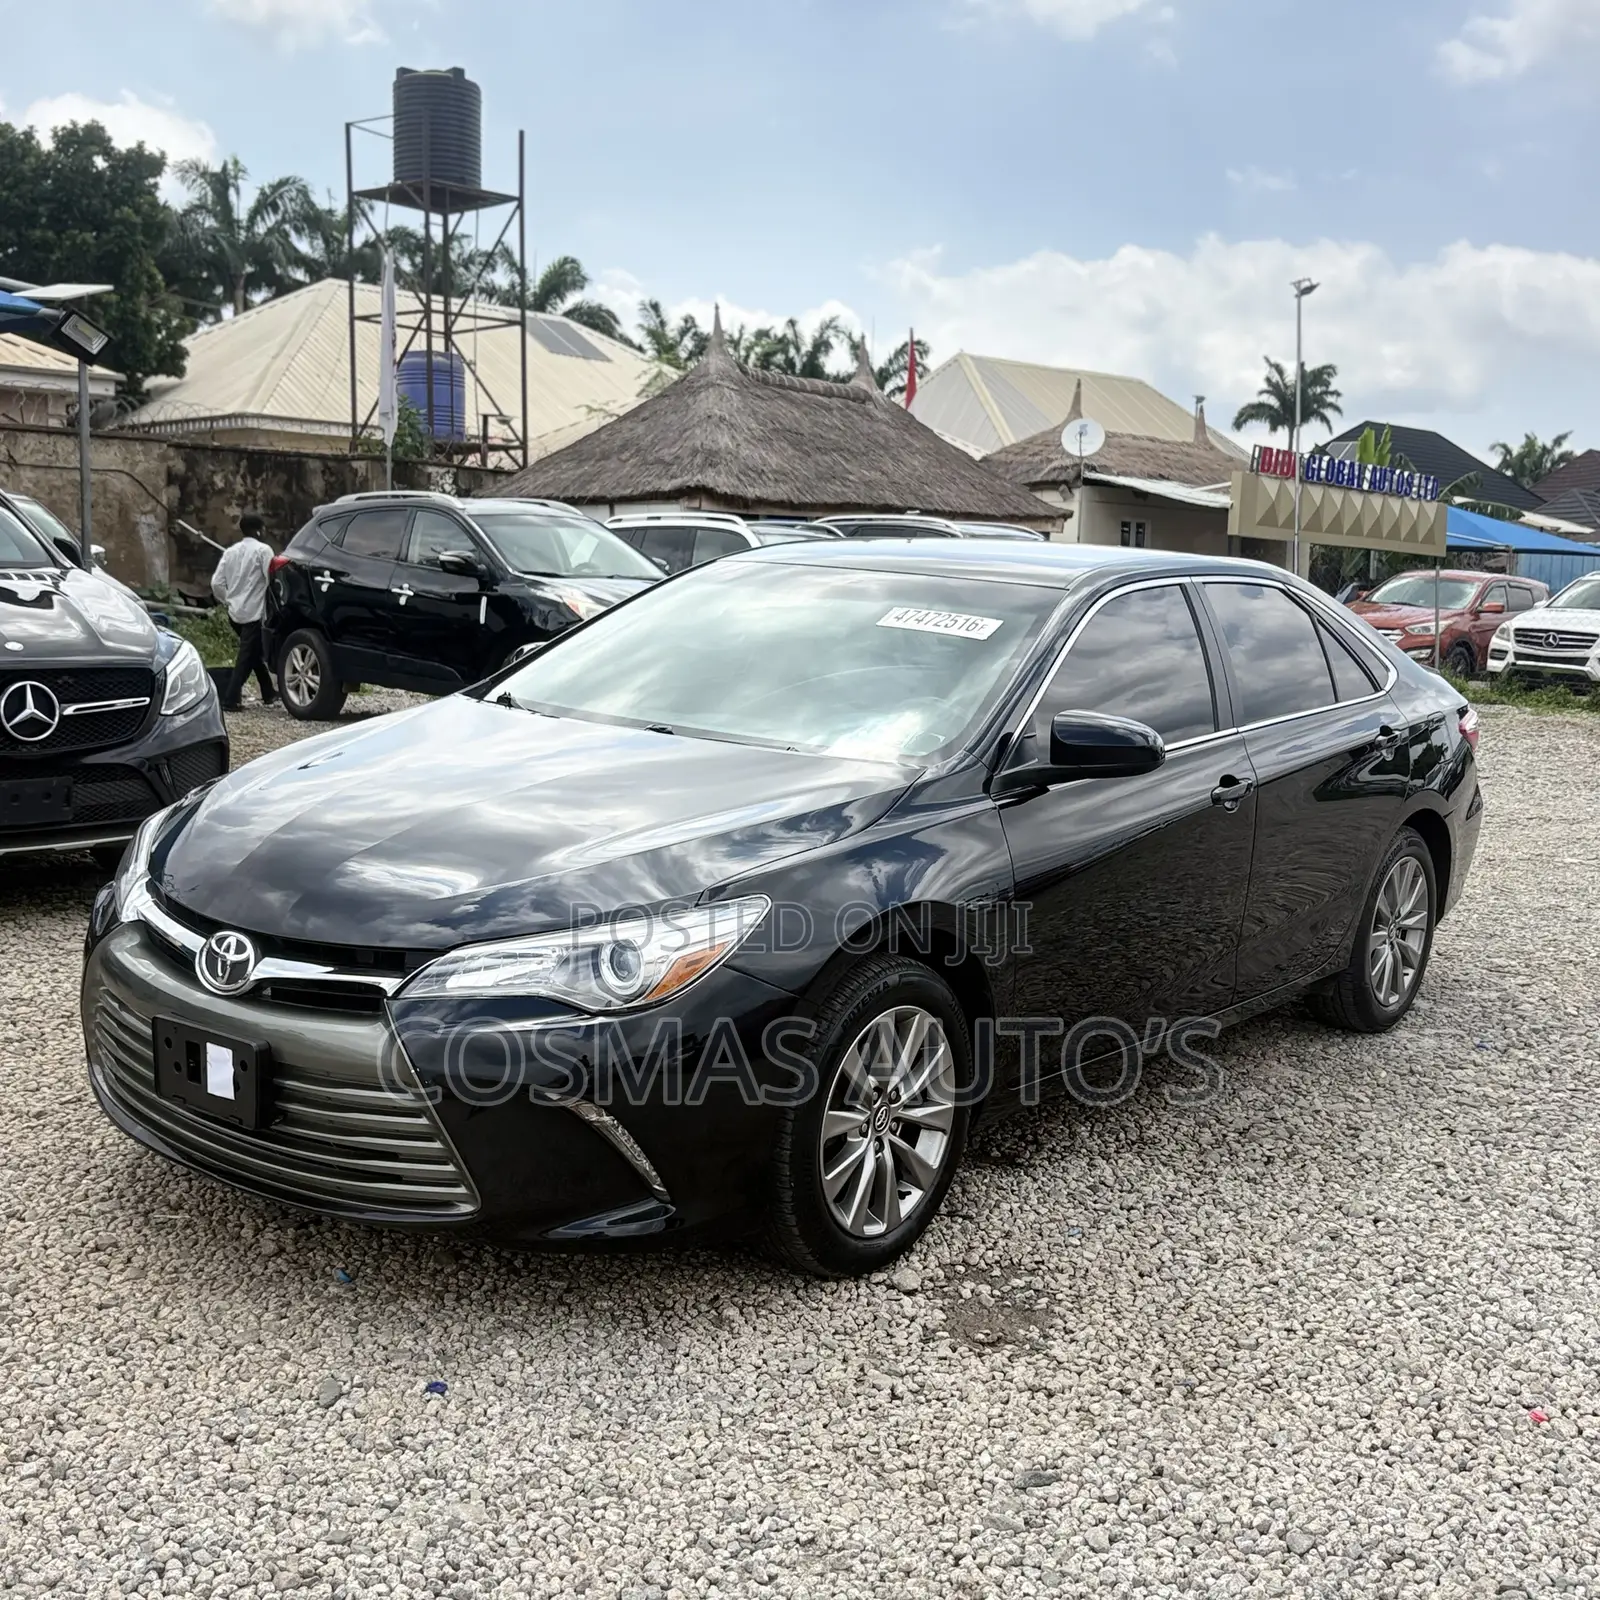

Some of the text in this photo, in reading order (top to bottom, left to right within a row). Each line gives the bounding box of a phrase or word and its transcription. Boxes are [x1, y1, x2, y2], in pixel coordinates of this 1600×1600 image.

[1305, 453, 1362, 489] GLOBAL
[1369, 465, 1414, 497] AUTOS
[1416, 472, 1439, 501] LTD
